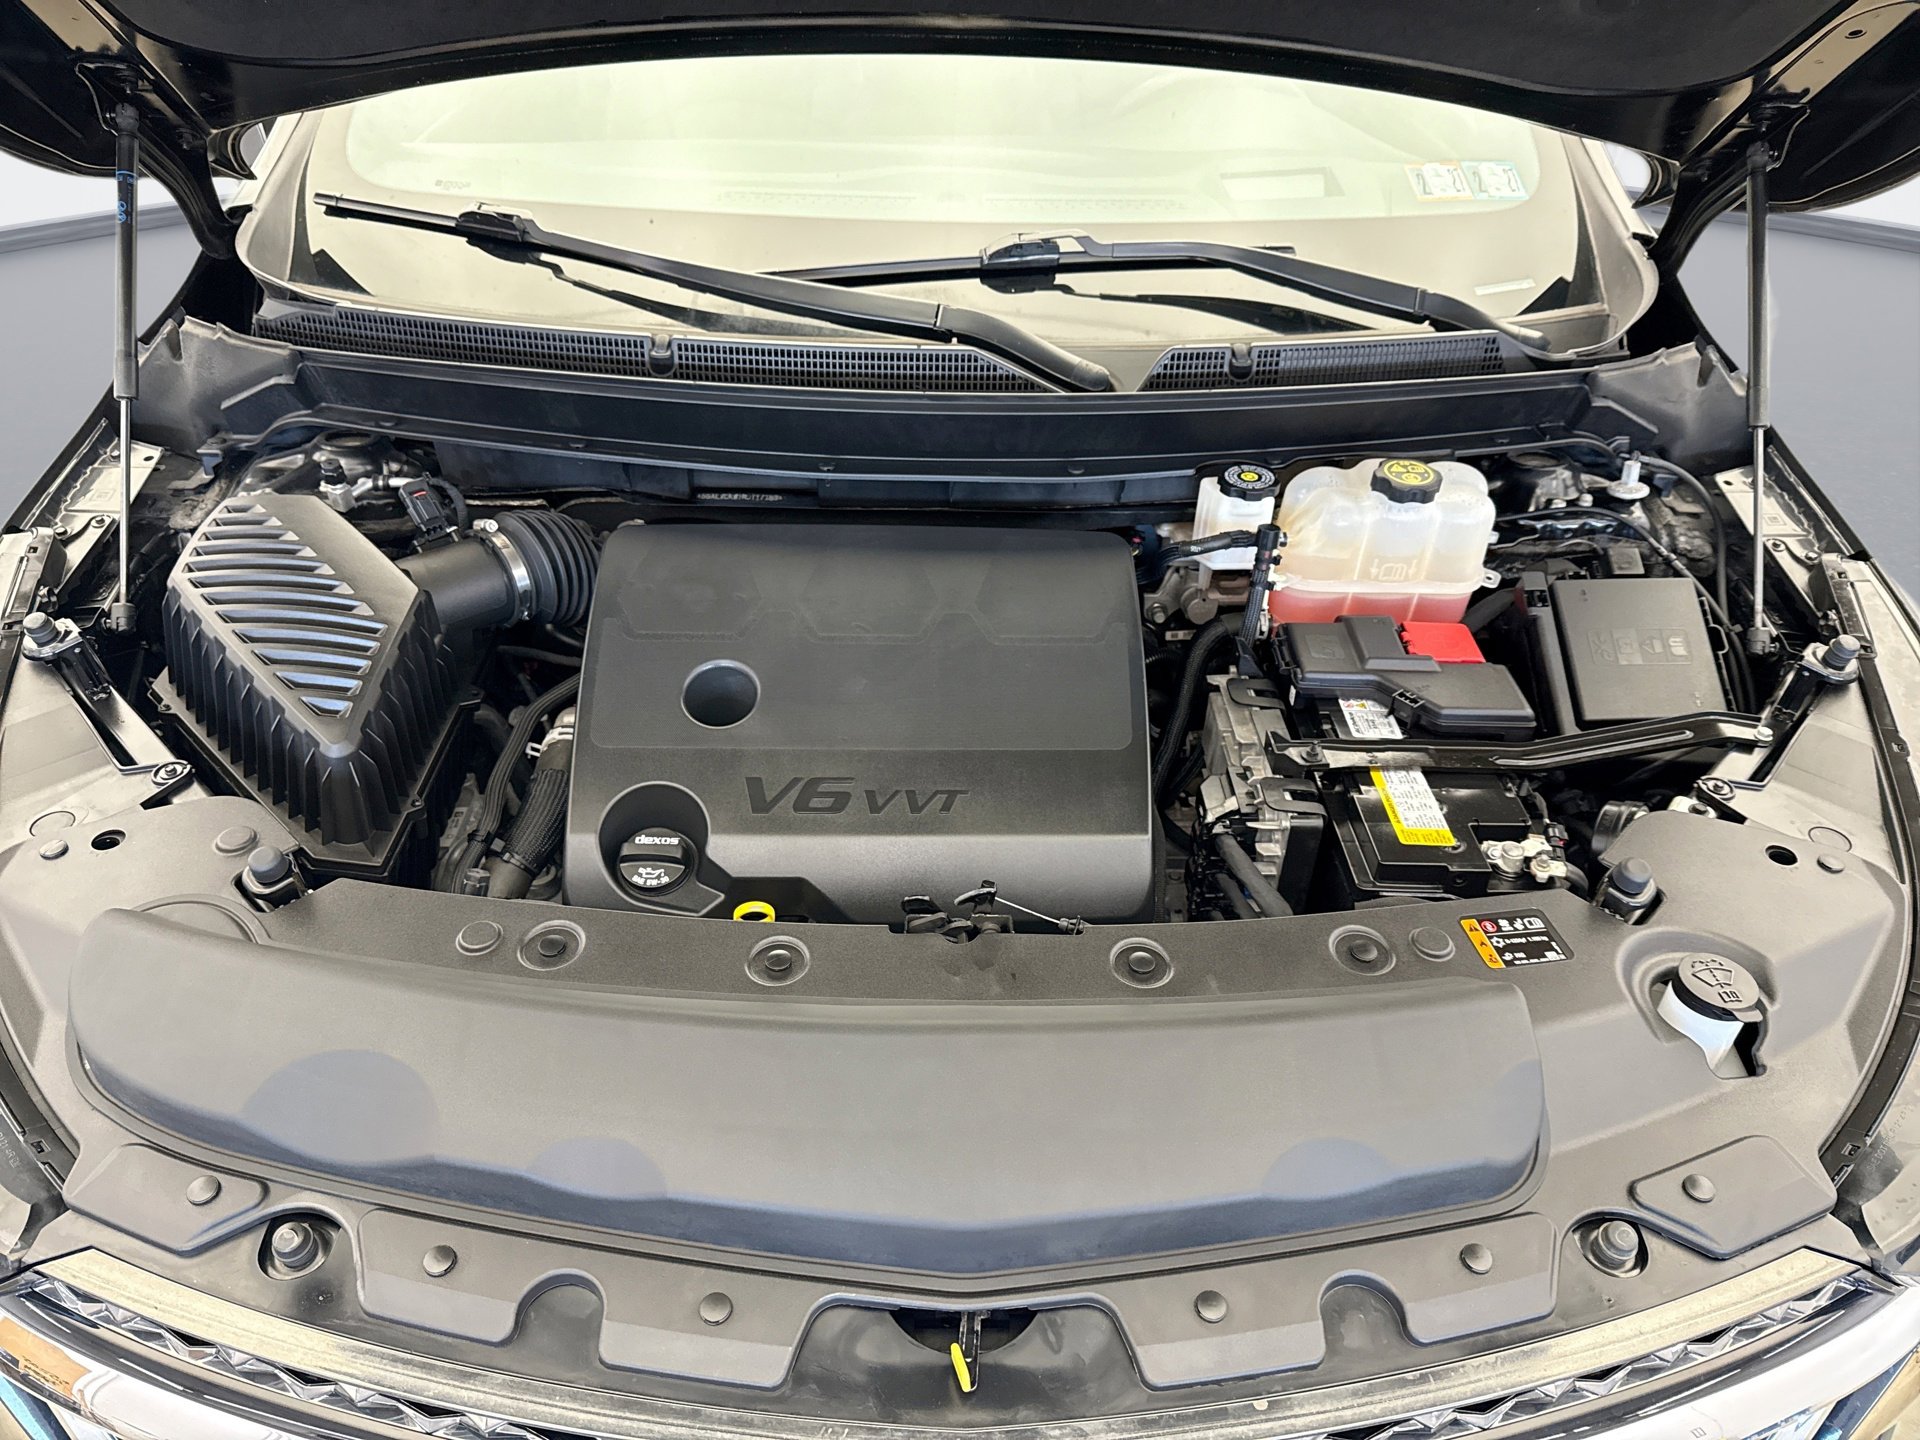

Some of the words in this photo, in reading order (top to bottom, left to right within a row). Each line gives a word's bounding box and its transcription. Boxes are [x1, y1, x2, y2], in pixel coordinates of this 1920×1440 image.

[745, 776, 857, 815] V6
[864, 789, 971, 815] VVT
[634, 834, 681, 845] dexos
[631, 875, 646, 885] SAE
[646, 875, 670, 886] 5W-30
